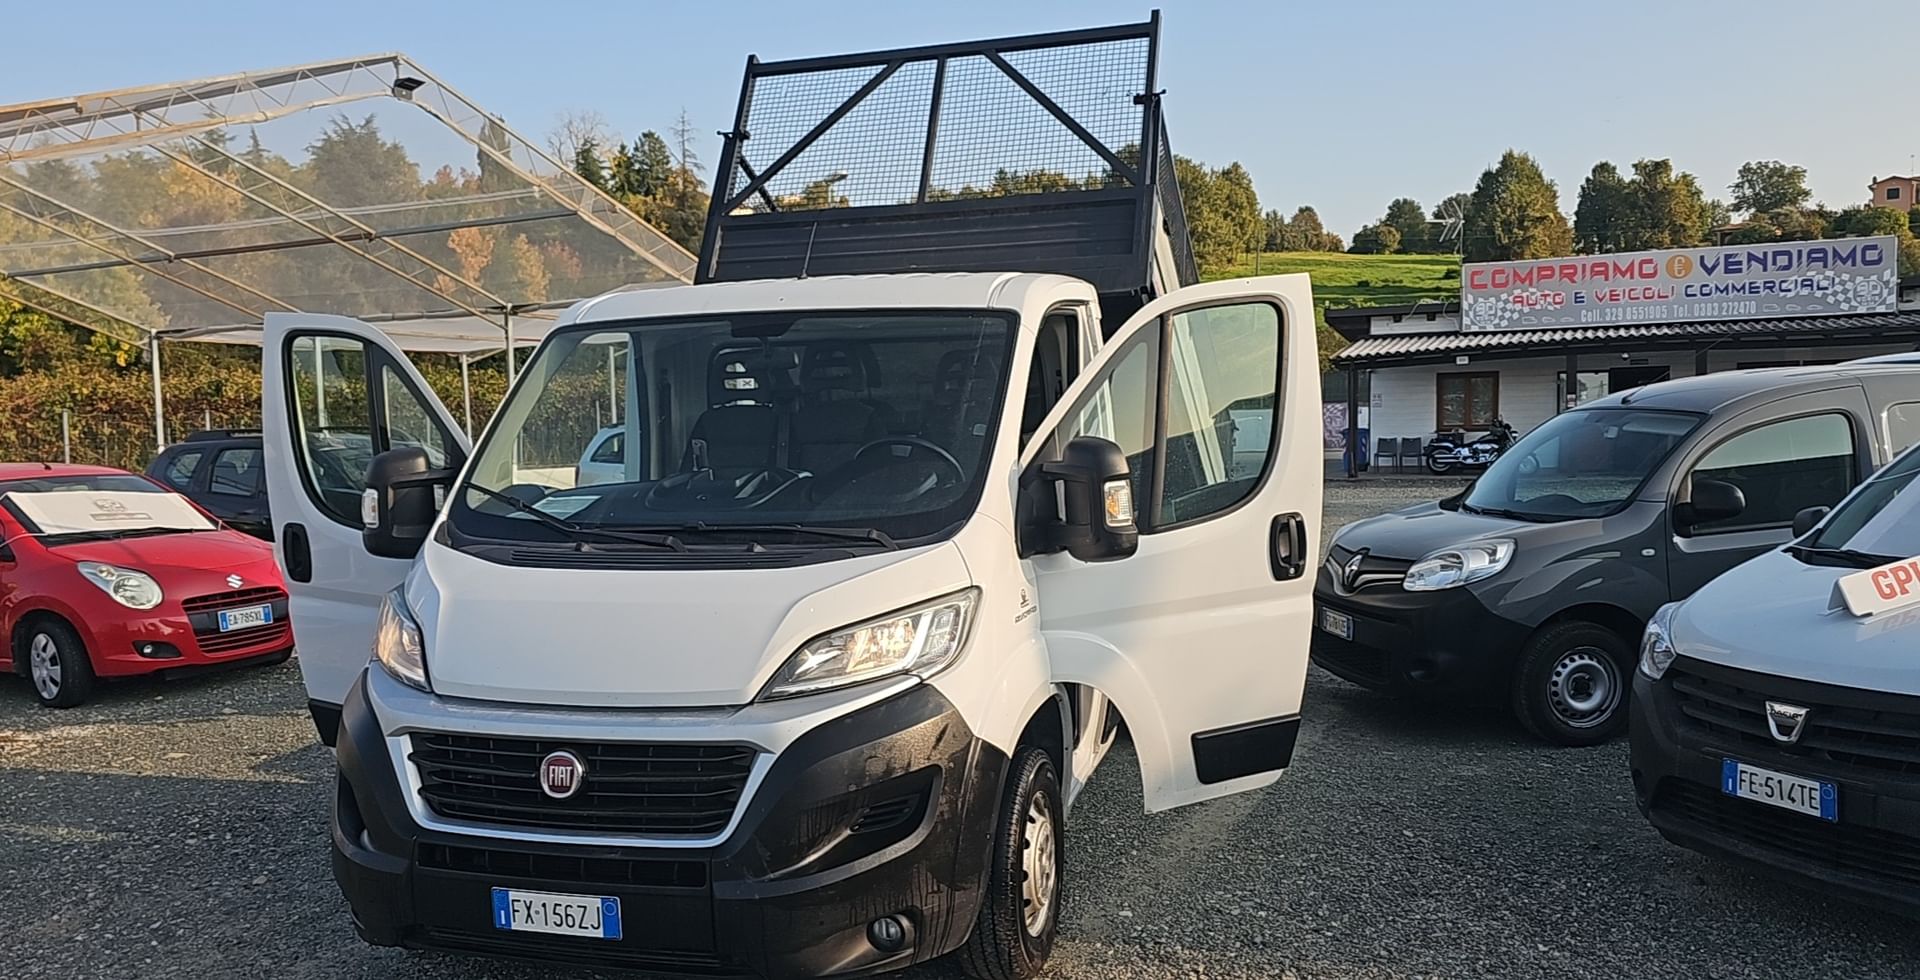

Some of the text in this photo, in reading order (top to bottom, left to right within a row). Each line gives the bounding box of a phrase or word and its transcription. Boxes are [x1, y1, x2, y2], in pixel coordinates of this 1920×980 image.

[1469, 258, 1659, 290] COMPRIAMO
[1699, 243, 1884, 277] VENDIAMO
[1511, 276, 1836, 307] AUTO E VEICOLI COMMERCIALI
[1605, 308, 1623, 321] 329
[1673, 304, 1691, 318] Tel.
[549, 765, 573, 787] FIAT
